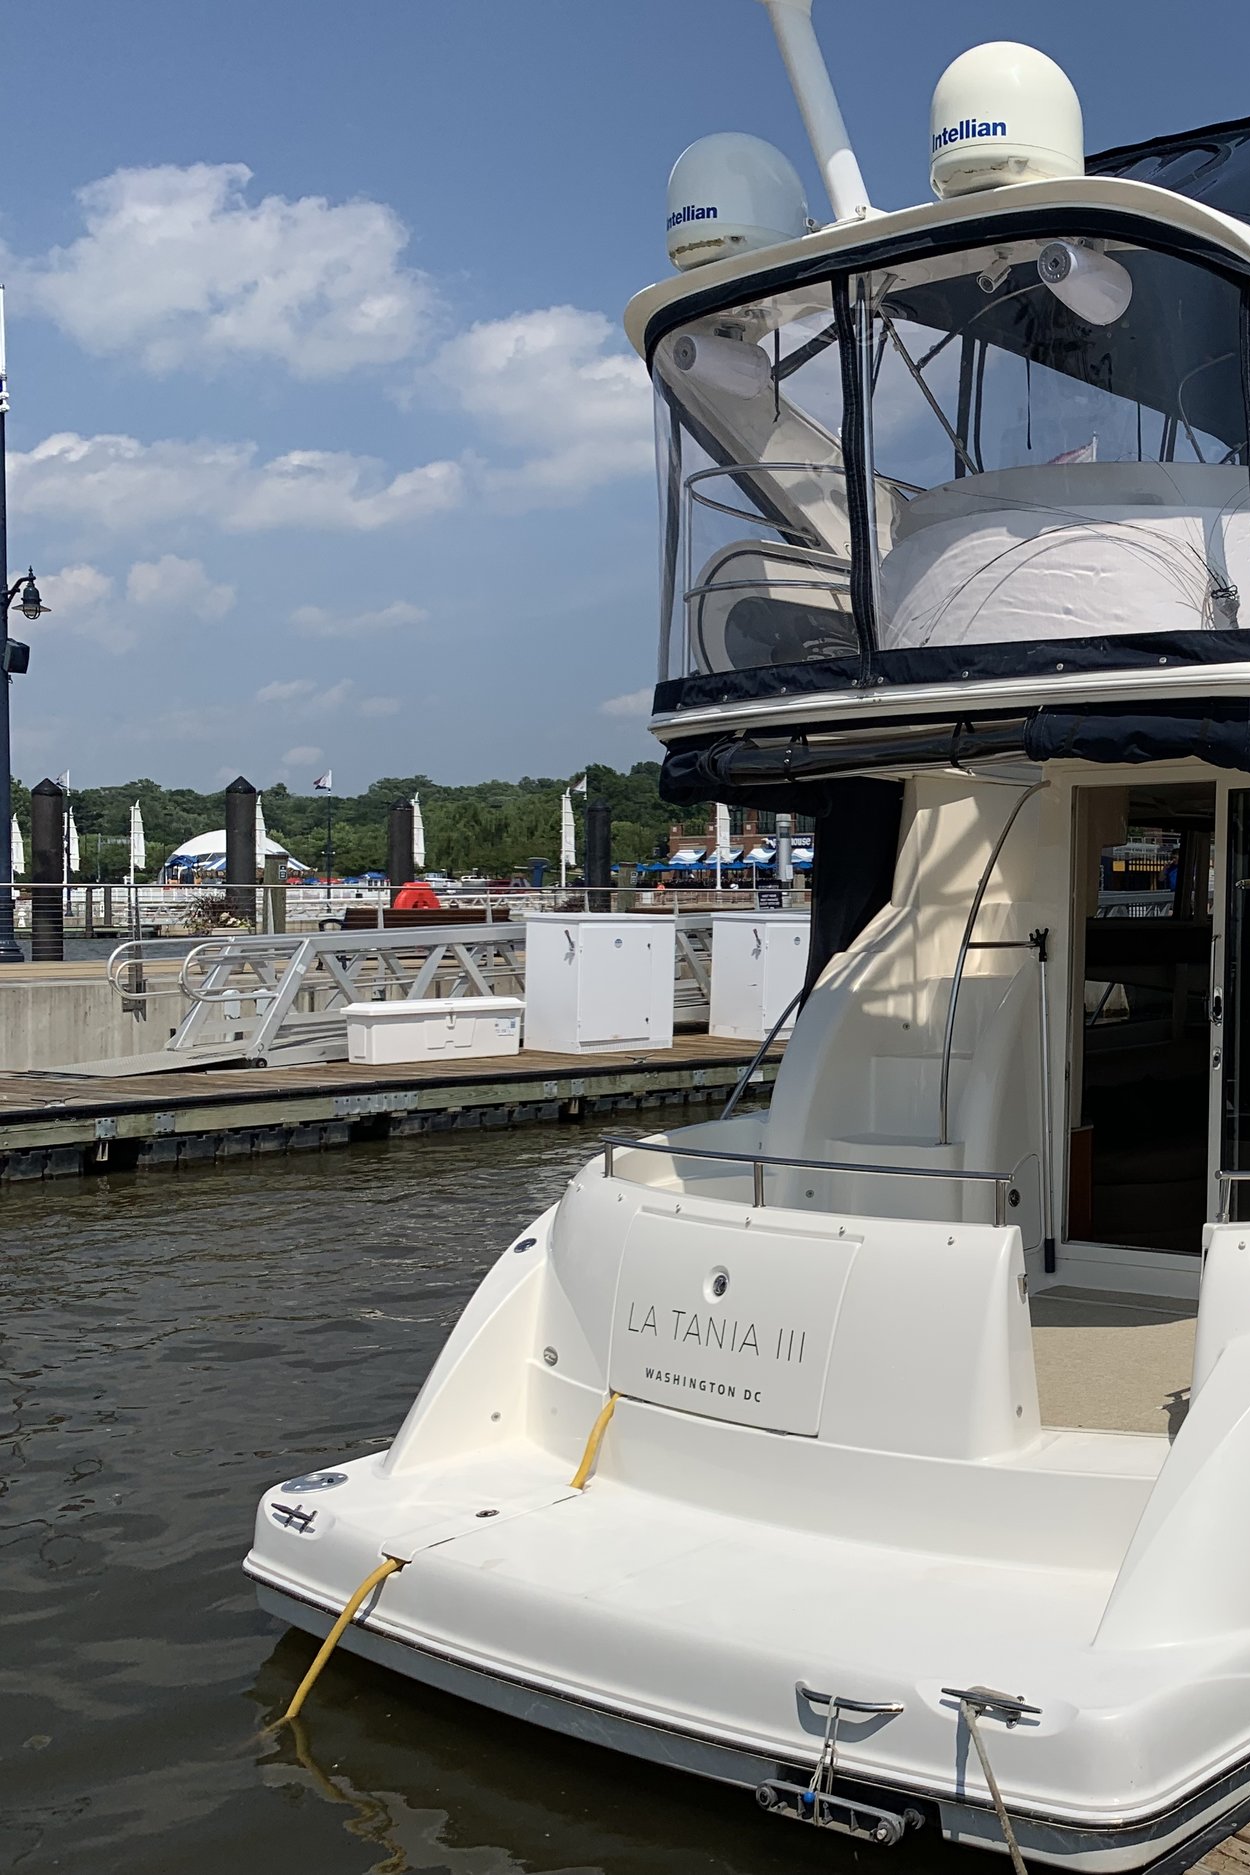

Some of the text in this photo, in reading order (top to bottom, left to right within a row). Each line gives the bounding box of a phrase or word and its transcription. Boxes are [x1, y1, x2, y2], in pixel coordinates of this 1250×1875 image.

[932, 118, 1007, 153] Intellian
[627, 1301, 806, 1364] LA TANIA III
[645, 1367, 762, 1403] WASHINGTON DC
